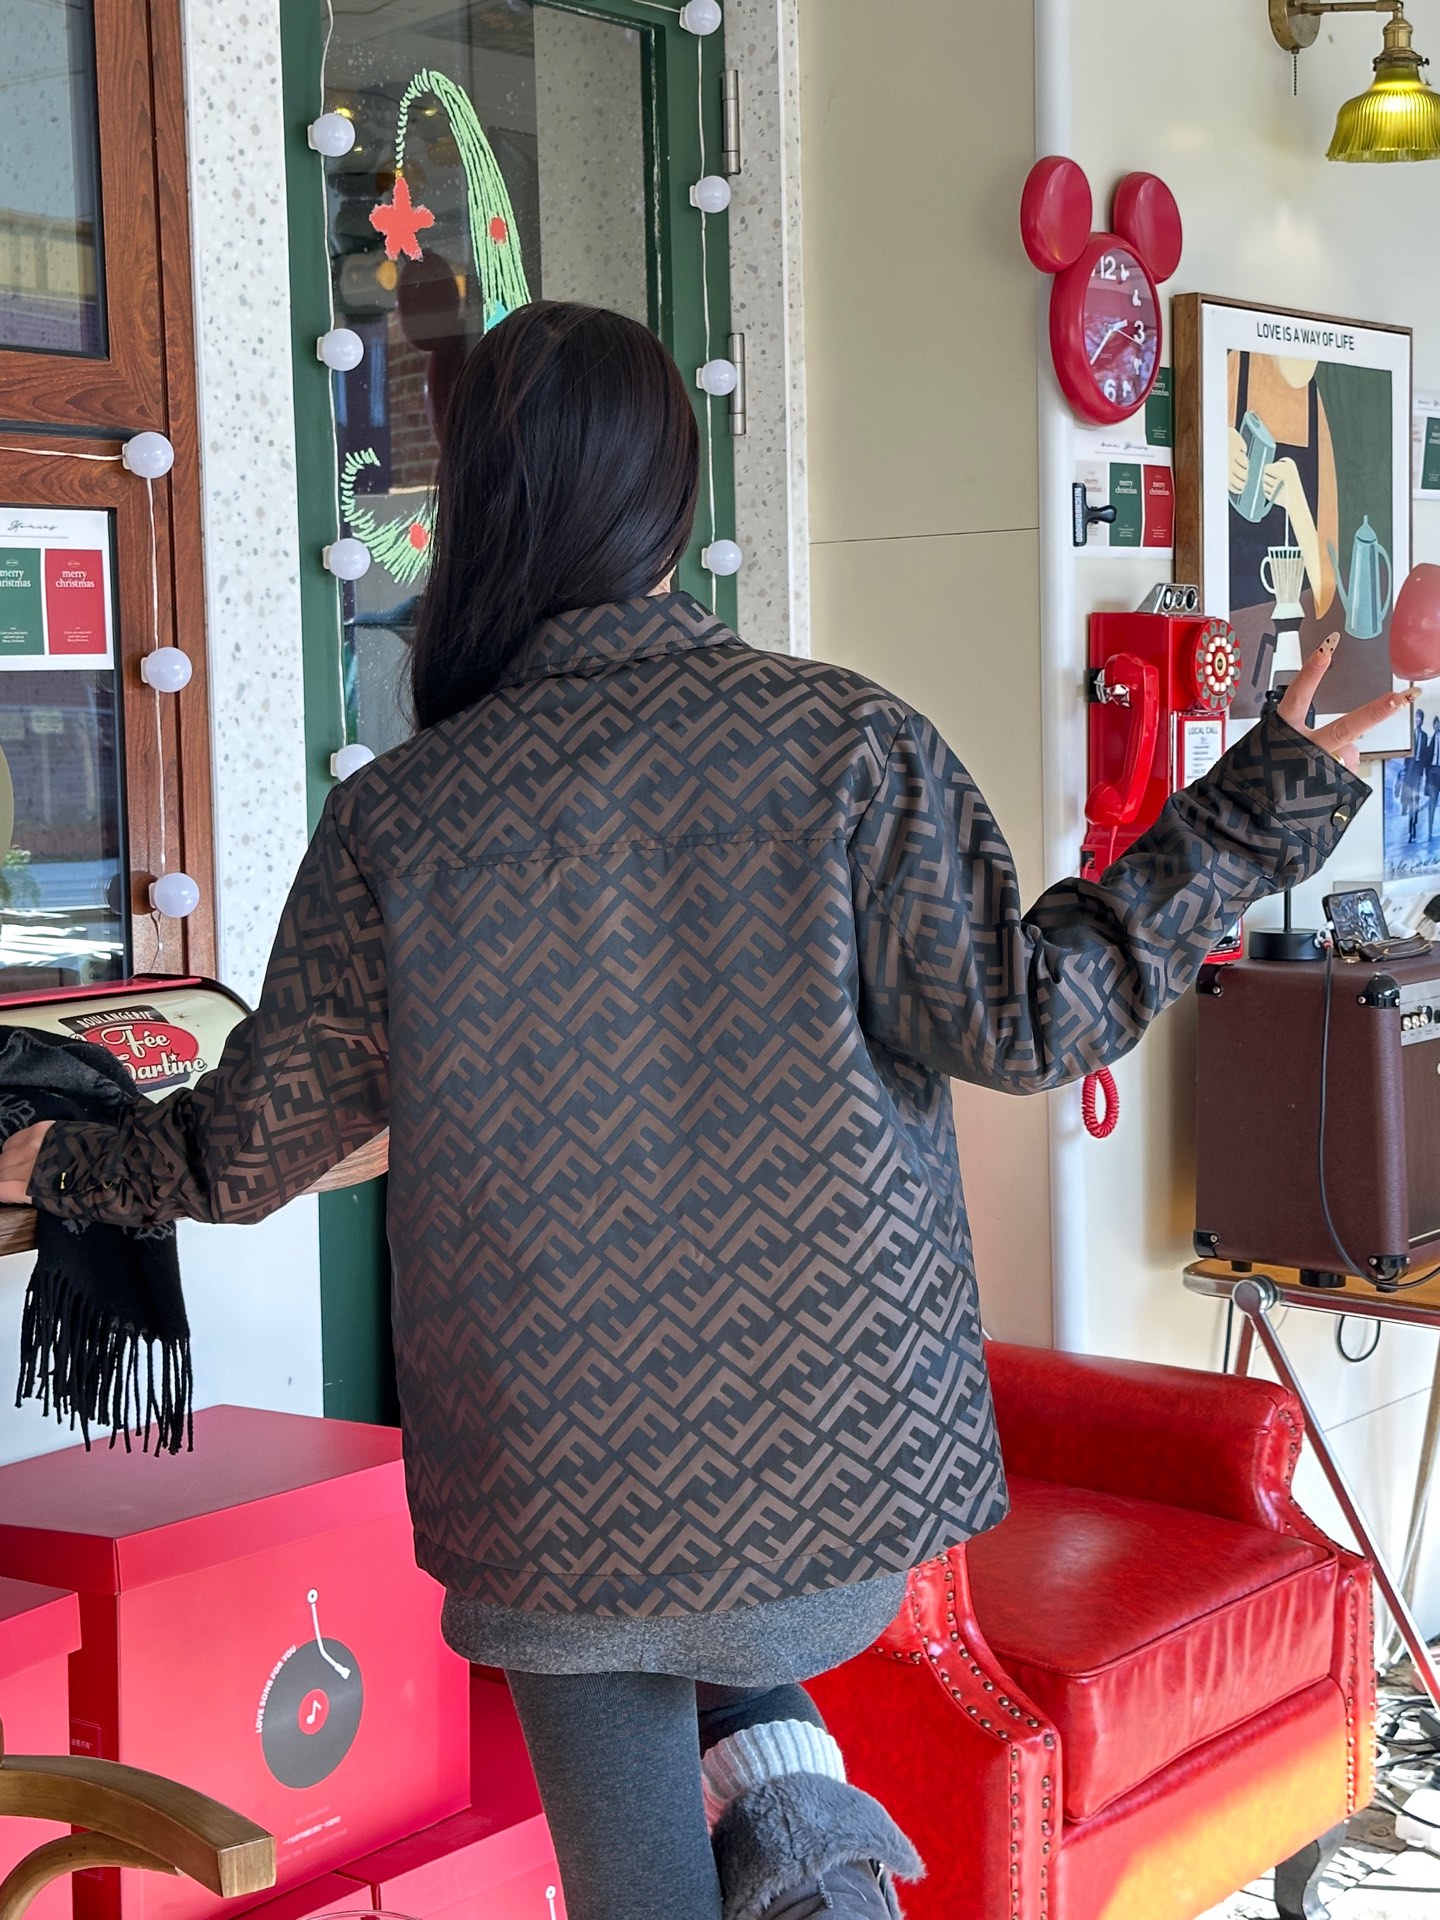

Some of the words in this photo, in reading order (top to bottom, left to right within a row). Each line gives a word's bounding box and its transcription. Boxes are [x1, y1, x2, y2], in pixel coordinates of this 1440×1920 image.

[1099, 255, 1117, 281] 12
[1132, 319, 1146, 347] 3
[1256, 322, 1281, 341] LOVE
[1282, 326, 1292, 342] IS
[1293, 328, 1300, 343] A
[1300, 329, 1321, 346] WAY
[1322, 332, 1334, 347] OF
[1335, 333, 1355, 351] LIFE
[1103, 378, 1117, 403] 6
[0, 570, 25, 581] merry
[0, 577, 32, 588] ristmas
[55, 577, 95, 588] christmas
[61, 570, 88, 581] merry
[1188, 726, 1205, 735] LOCAL
[1206, 726, 1218, 735] CALL
[76, 1010, 155, 1028] BOULANGERIE
[101, 1025, 171, 1059] Fée
[281, 1644, 297, 1662] YOU
[269, 1660, 284, 1680] FOR
[259, 1679, 274, 1707] SONG
[255, 1708, 265, 1734] LOVE
